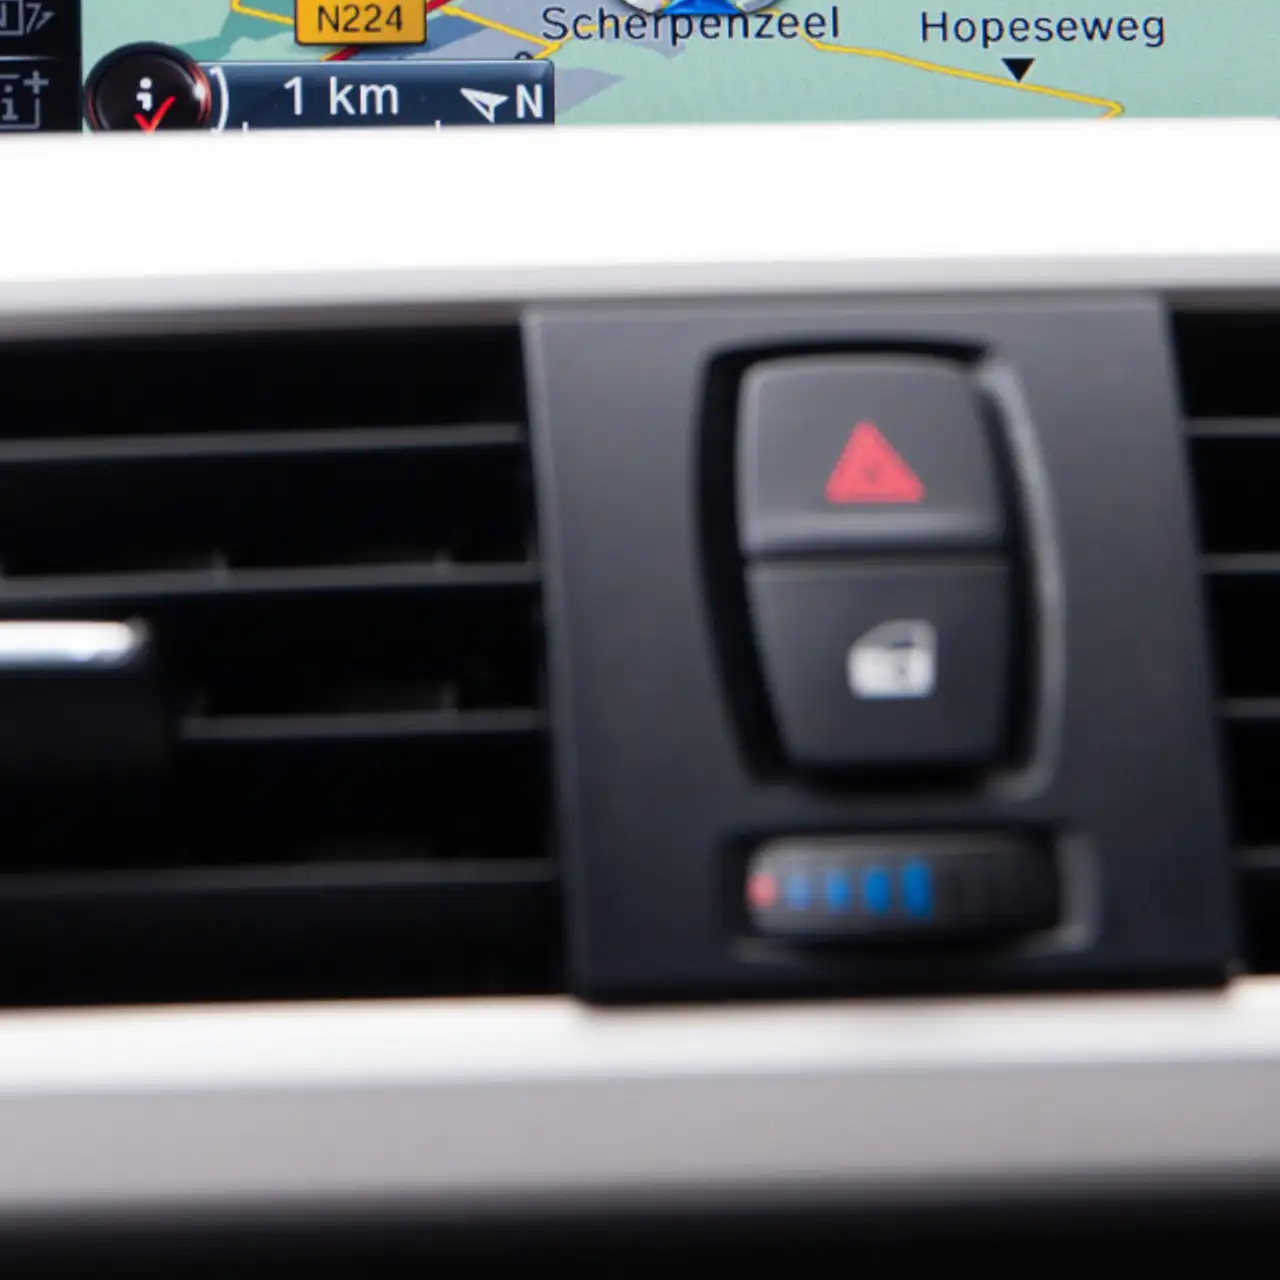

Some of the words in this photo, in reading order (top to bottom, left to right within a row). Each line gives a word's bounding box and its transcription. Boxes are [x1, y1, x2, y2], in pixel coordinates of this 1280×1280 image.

[317, 4, 404, 33] N224
[542, 6, 839, 46] Scherpenzeel
[920, 10, 1166, 47] Hopeseweg
[283, 76, 303, 116] 1
[329, 76, 400, 116] km
[516, 84, 543, 119] N
